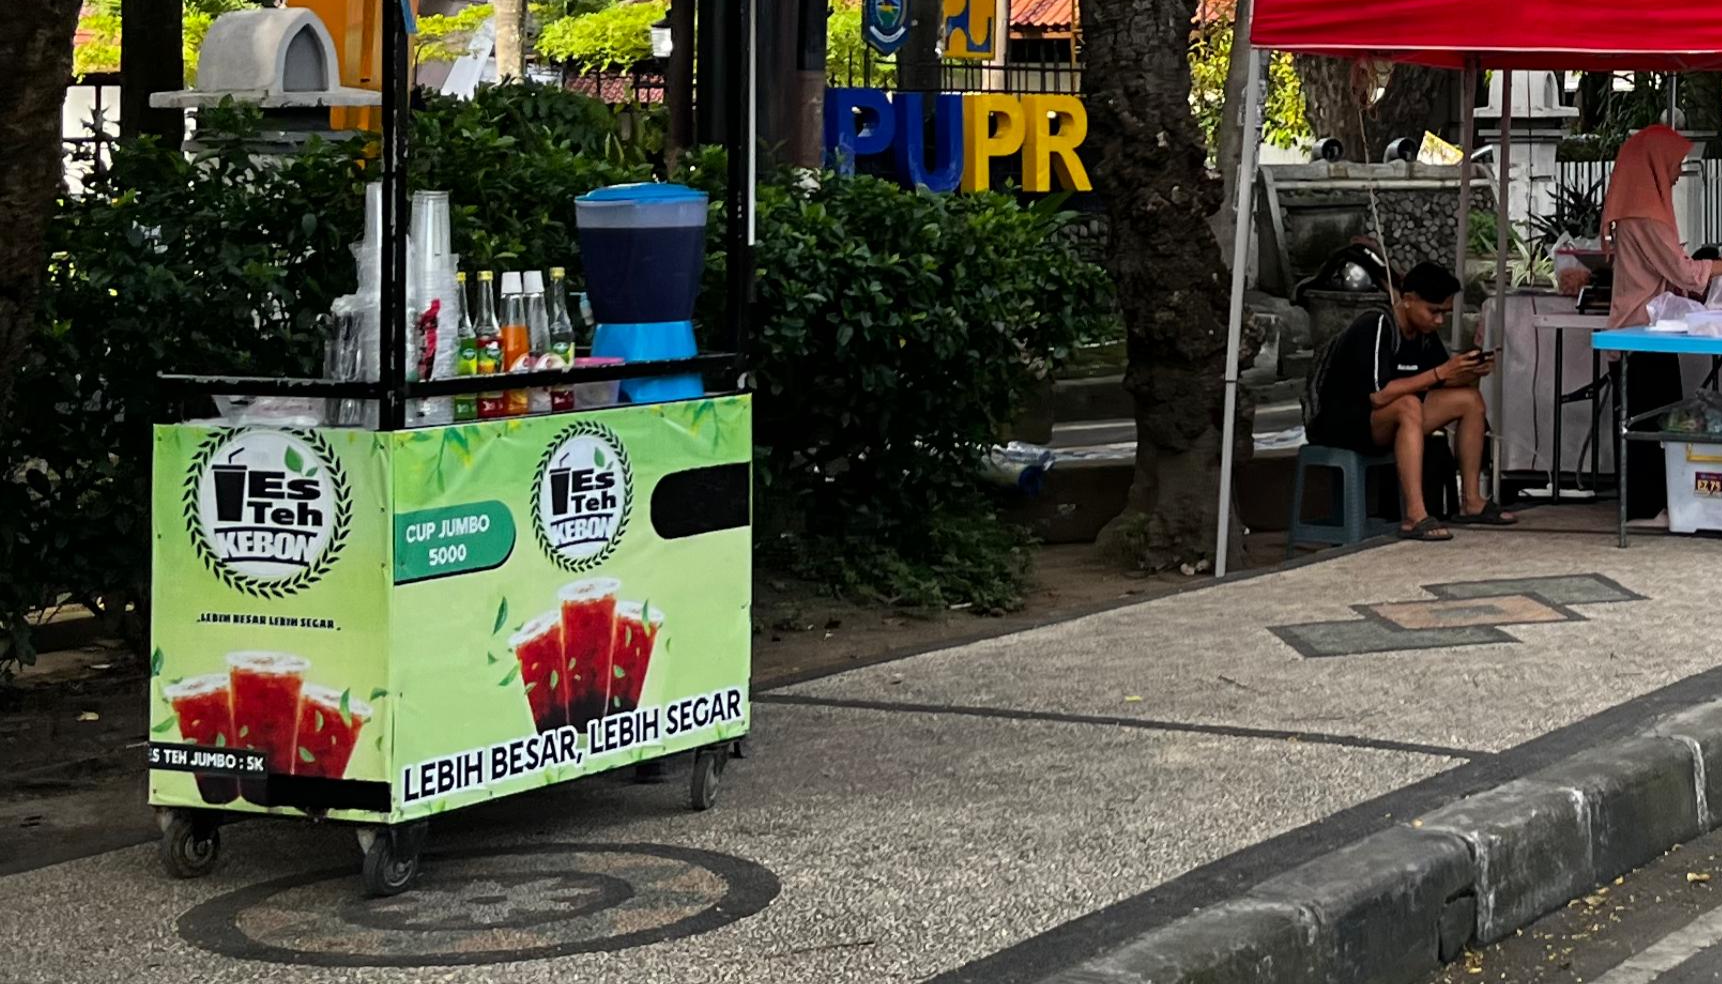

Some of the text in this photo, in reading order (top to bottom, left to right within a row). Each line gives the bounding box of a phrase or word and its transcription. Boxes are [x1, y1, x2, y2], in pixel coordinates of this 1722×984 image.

[824, 87, 1093, 193] PUPR
[248, 470, 321, 501] Es
[571, 468, 615, 493] Es
[247, 501, 323, 527] Teh
[571, 490, 617, 514] Teh
[406, 514, 490, 543] CUP JUMBO
[551, 516, 613, 546] KEBON
[215, 529, 317, 563] KEBON
[428, 544, 467, 565] 5000
[163, 749, 188, 765] TEH
[191, 751, 237, 768] JUMBO
[246, 756, 264, 772] 5K
[404, 689, 742, 803] LEBIH BESAR, LEBIH SEGAR
